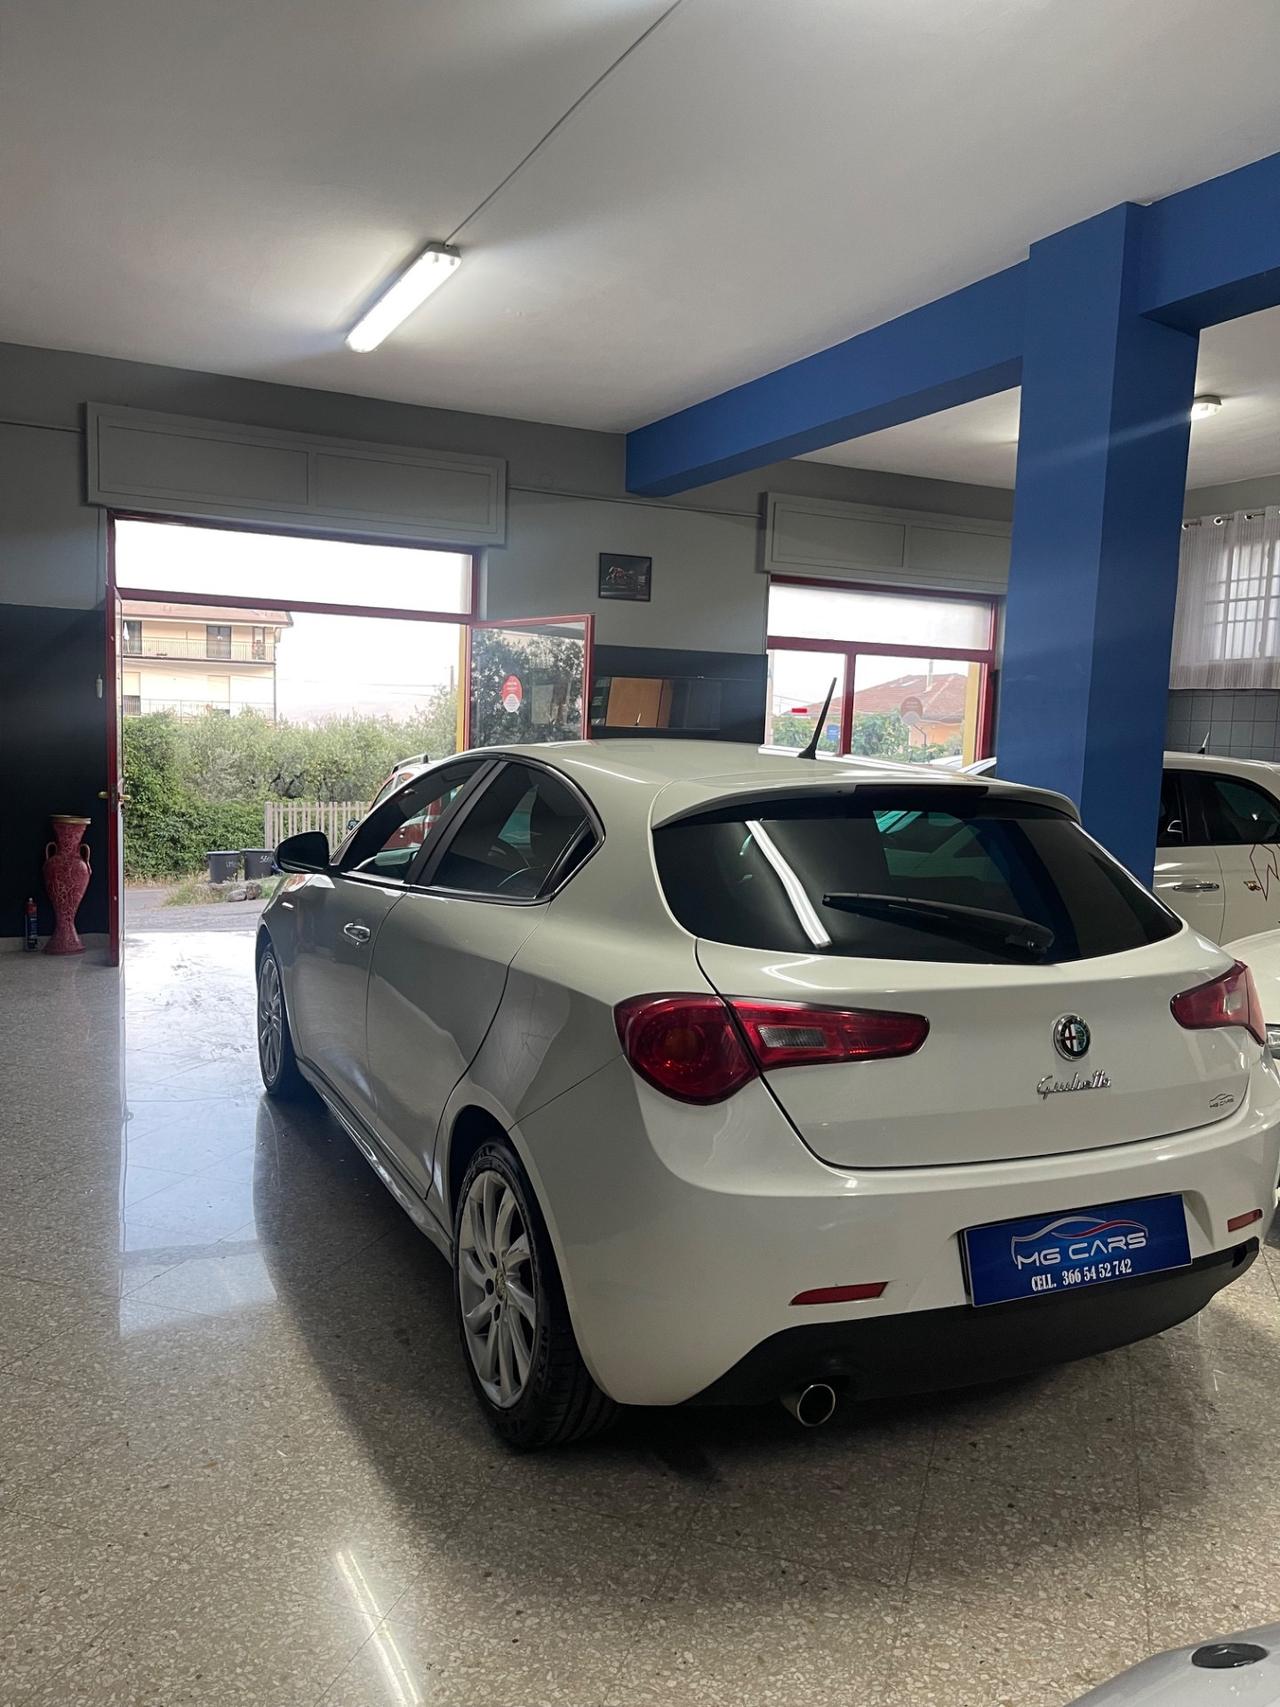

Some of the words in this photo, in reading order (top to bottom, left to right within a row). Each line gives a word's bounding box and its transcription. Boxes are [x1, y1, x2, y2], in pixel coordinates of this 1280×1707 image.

[1016, 1248, 1061, 1270] MG
[1068, 1232, 1147, 1260] CARS
[1031, 1274, 1057, 1291] CELL.
[1062, 1268, 1081, 1286] 366
[1083, 1265, 1097, 1281] 54
[1099, 1263, 1112, 1278] 52
[1113, 1258, 1132, 1274] 742
